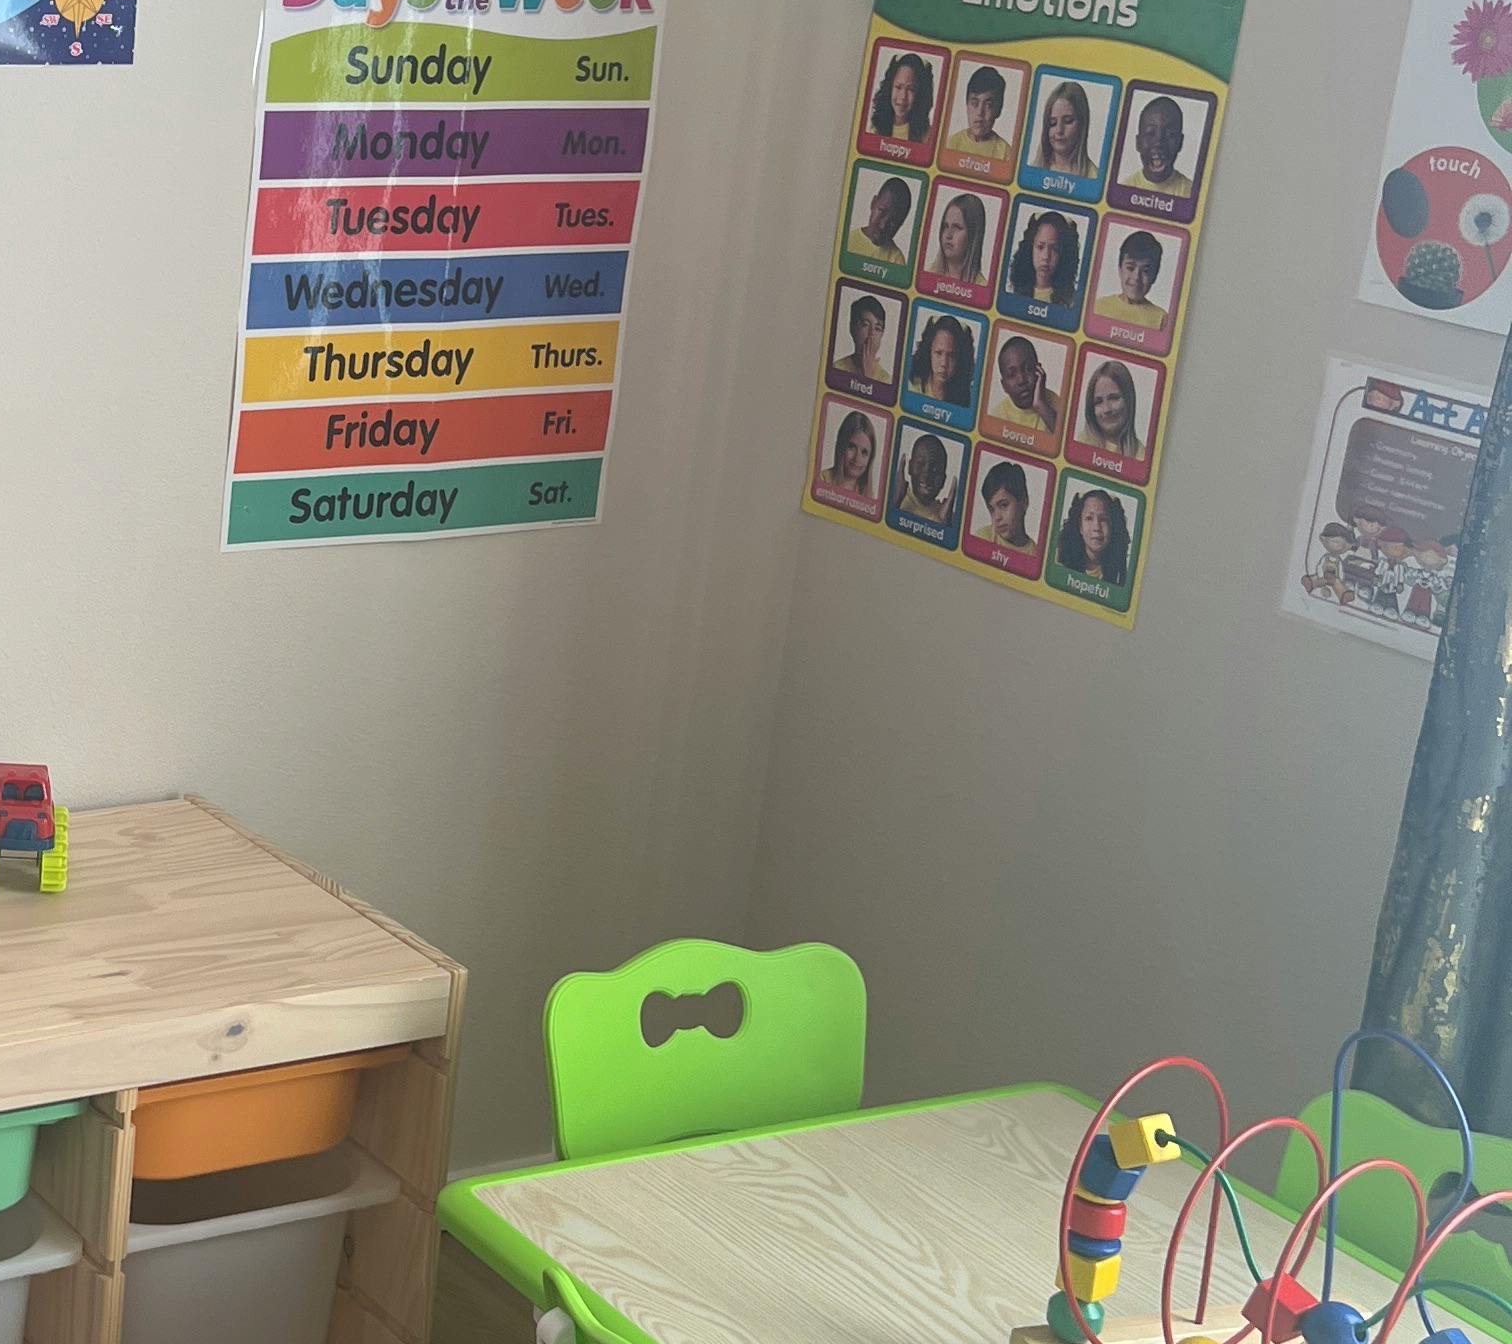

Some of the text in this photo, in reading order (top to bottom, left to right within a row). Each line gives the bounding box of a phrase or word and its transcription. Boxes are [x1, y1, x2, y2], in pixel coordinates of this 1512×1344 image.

[43, 15, 58, 25] SW
[97, 15, 112, 25] SE
[71, 42, 82, 56] S
[345, 44, 629, 95] Sunday Sun.
[332, 120, 626, 170] Monday Mon.
[880, 139, 912, 158] happy
[958, 157, 991, 173] afraid
[1430, 156, 1481, 179] touch
[1042, 175, 1075, 194] guilty
[1130, 192, 1173, 213] excited
[326, 194, 615, 242] Tuesday Tues.
[862, 261, 889, 279] sorry
[285, 267, 605, 315] Wednesday Wed.
[933, 280, 972, 299] jealous
[1027, 303, 1047, 318] sad
[1110, 325, 1145, 344] proud
[304, 339, 603, 385] Thursday Thurs.
[849, 378, 873, 396] tired
[922, 402, 952, 423] angry
[1409, 390, 1458, 426] Art
[325, 411, 577, 455] Friday Fri.
[1002, 426, 1035, 446] bored
[1091, 453, 1122, 474] loved
[289, 481, 572, 525] Saturday Sat.
[898, 516, 944, 541] surprised
[991, 549, 1009, 567] shy
[1066, 574, 1110, 600] hopeful
